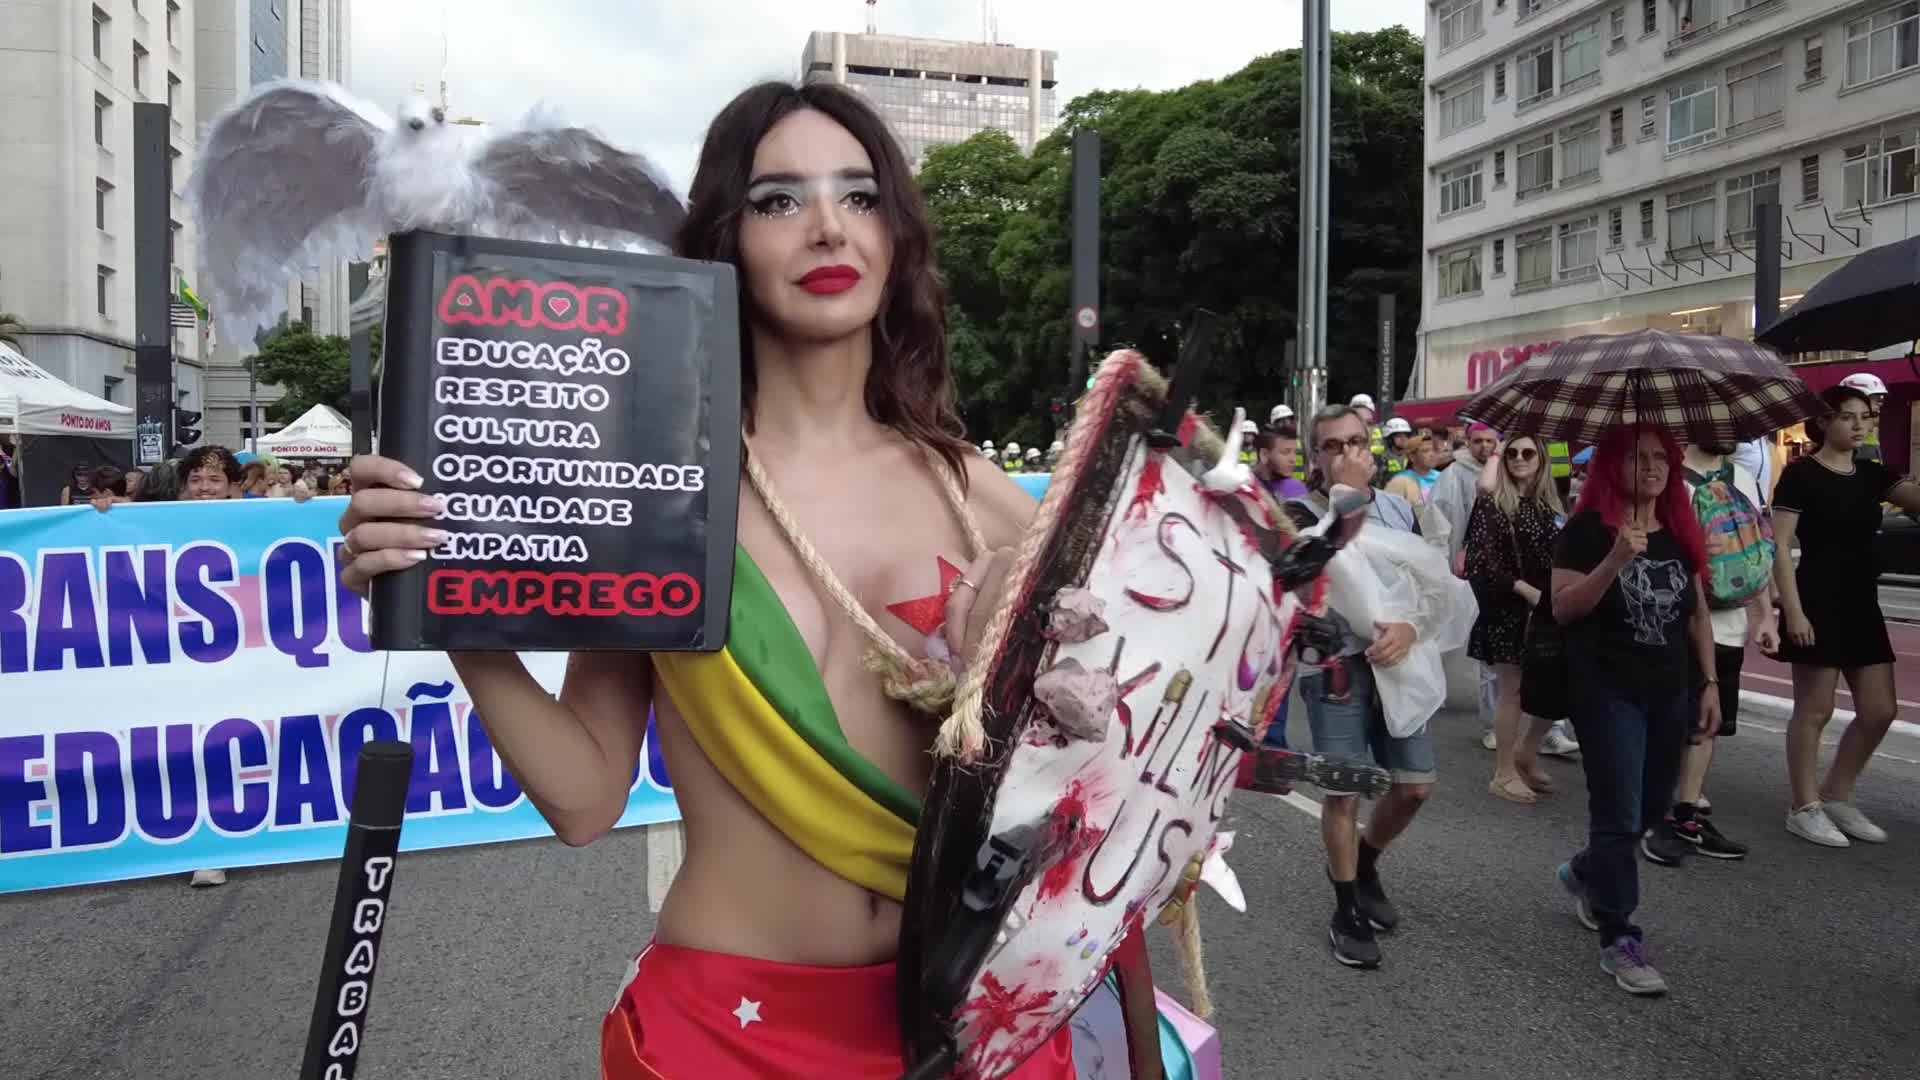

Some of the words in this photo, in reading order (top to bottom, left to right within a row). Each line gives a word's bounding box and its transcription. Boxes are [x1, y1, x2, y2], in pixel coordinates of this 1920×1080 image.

[439, 275, 629, 335] AMOR
[435, 337, 630, 376] EDUCAÇÃO
[435, 377, 609, 411] RESPEITO
[61, 413, 84, 429] PONTO
[85, 417, 94, 430] DO
[434, 414, 600, 449] CULTURA
[432, 453, 705, 491] OPORTUNIDADE
[433, 493, 632, 526] GUALDADE
[431, 532, 588, 562] EMPATIA
[428, 570, 700, 616] EMPREGO
[1082, 799, 1193, 906] US
